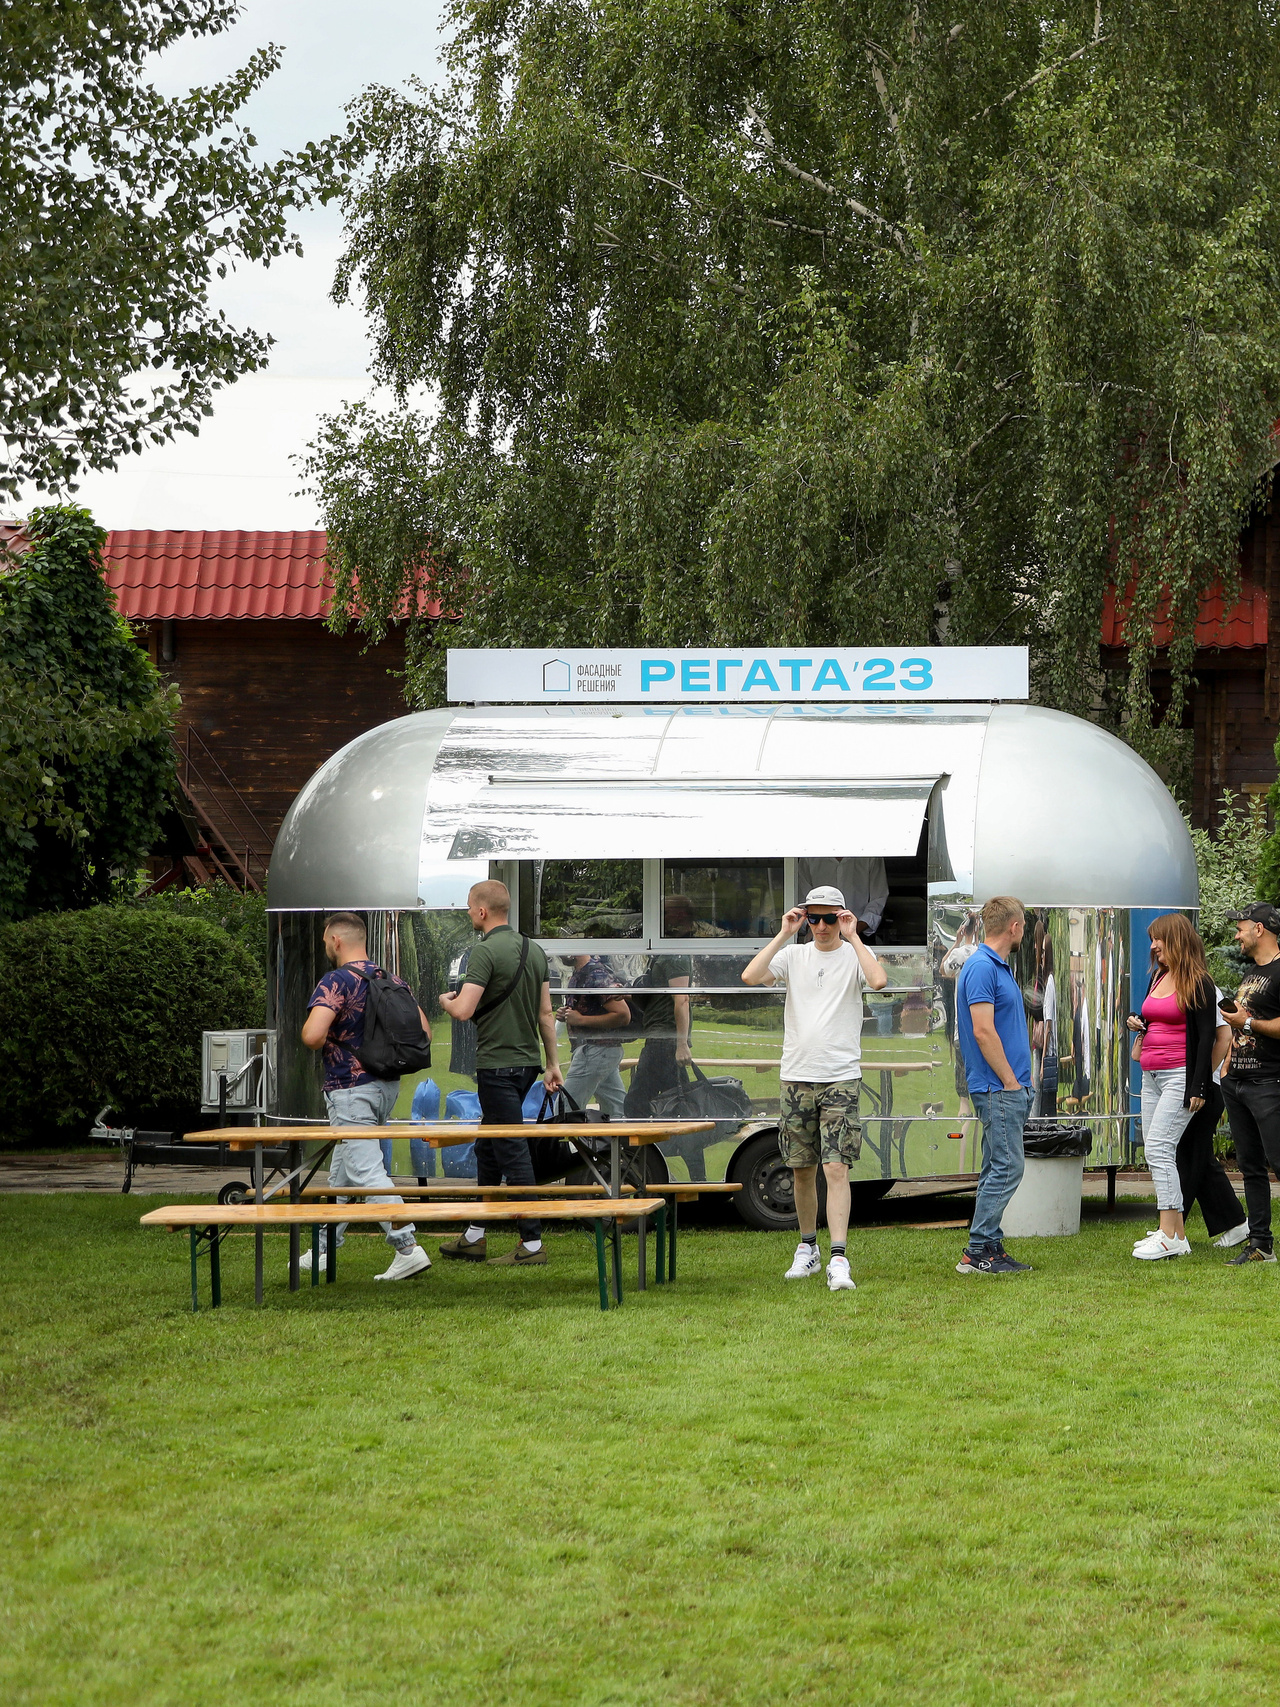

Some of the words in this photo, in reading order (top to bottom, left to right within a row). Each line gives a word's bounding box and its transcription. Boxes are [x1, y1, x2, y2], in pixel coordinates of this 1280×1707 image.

[576, 664, 622, 678] ФАСАДНЫЕ
[640, 658, 934, 692] РЕГАТА'23
[577, 680, 616, 692] РЕШЕНИЯ
